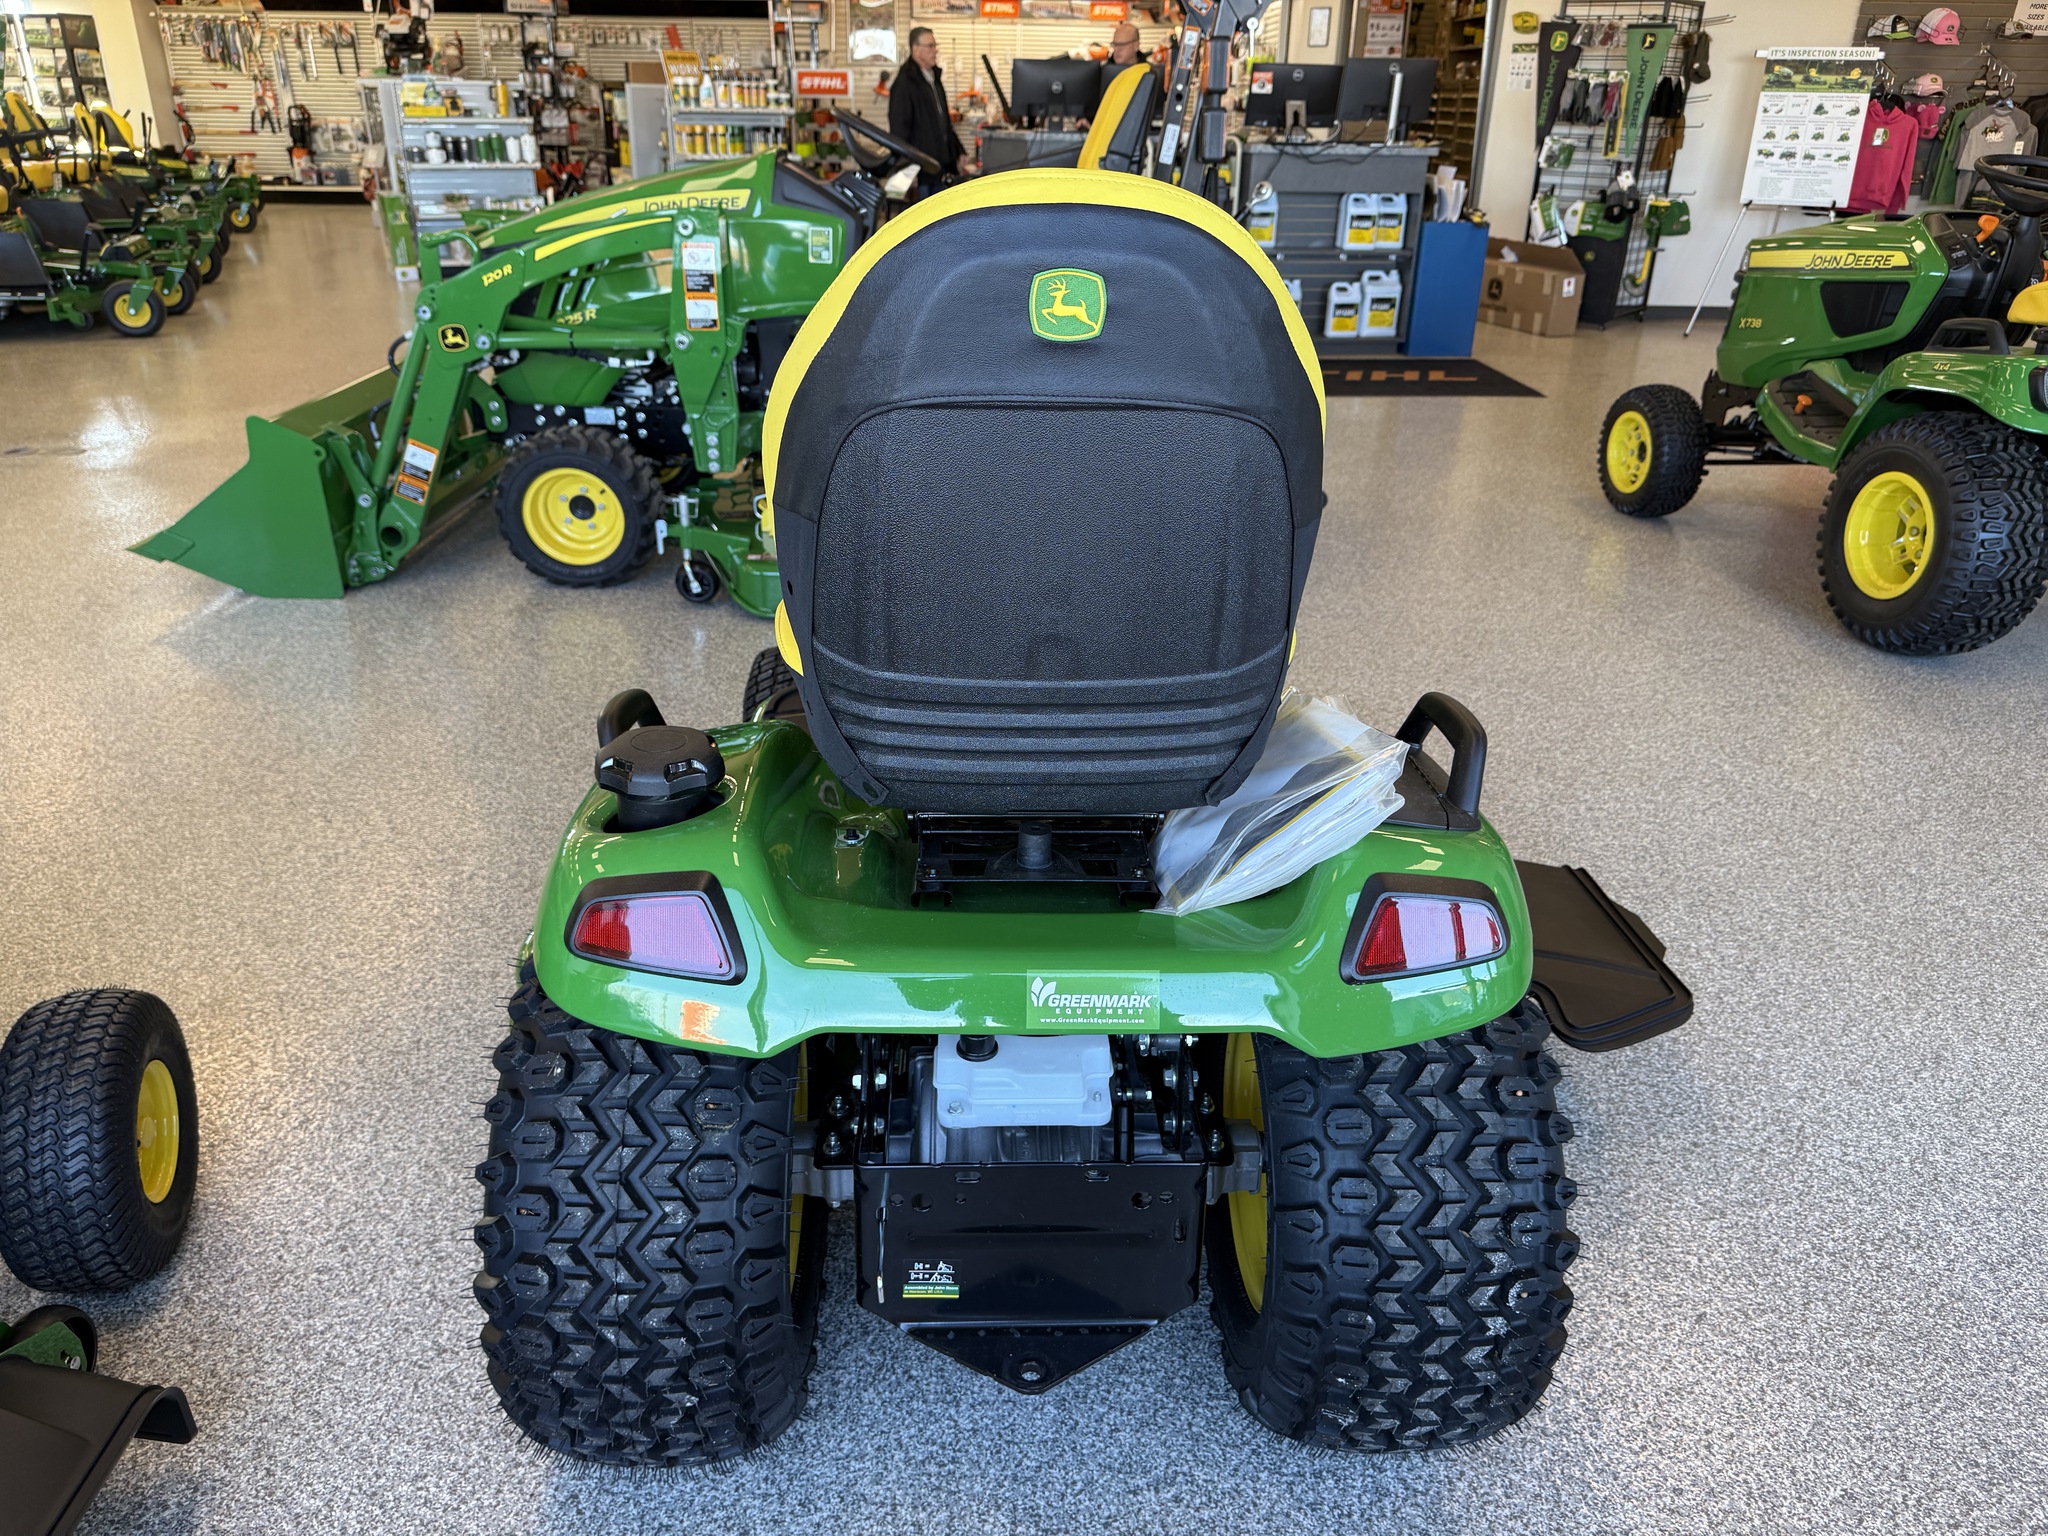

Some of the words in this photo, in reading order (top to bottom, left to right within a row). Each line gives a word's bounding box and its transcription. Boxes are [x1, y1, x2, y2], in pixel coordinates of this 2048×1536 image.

[983, 3, 1015, 14] STIHL
[1092, 5, 1124, 16] STIHL
[1770, 49, 1786, 57] IT'S
[1788, 49, 1837, 57] INSPECTION
[1839, 50, 1876, 58] SEASON!
[1546, 55, 1560, 88] JOHN
[1636, 56, 1650, 89] JOHN
[800, 76, 845, 90] STIHL
[1537, 89, 1554, 127] DEERE
[1629, 91, 1645, 130] DEERE
[644, 200, 682, 213] JOHN
[687, 196, 740, 210] DEERE
[1805, 253, 1843, 268] JOHN
[1843, 252, 1895, 267] DEERE
[1738, 317, 1762, 329] X738
[1048, 994, 1152, 1008] GREENMARK
